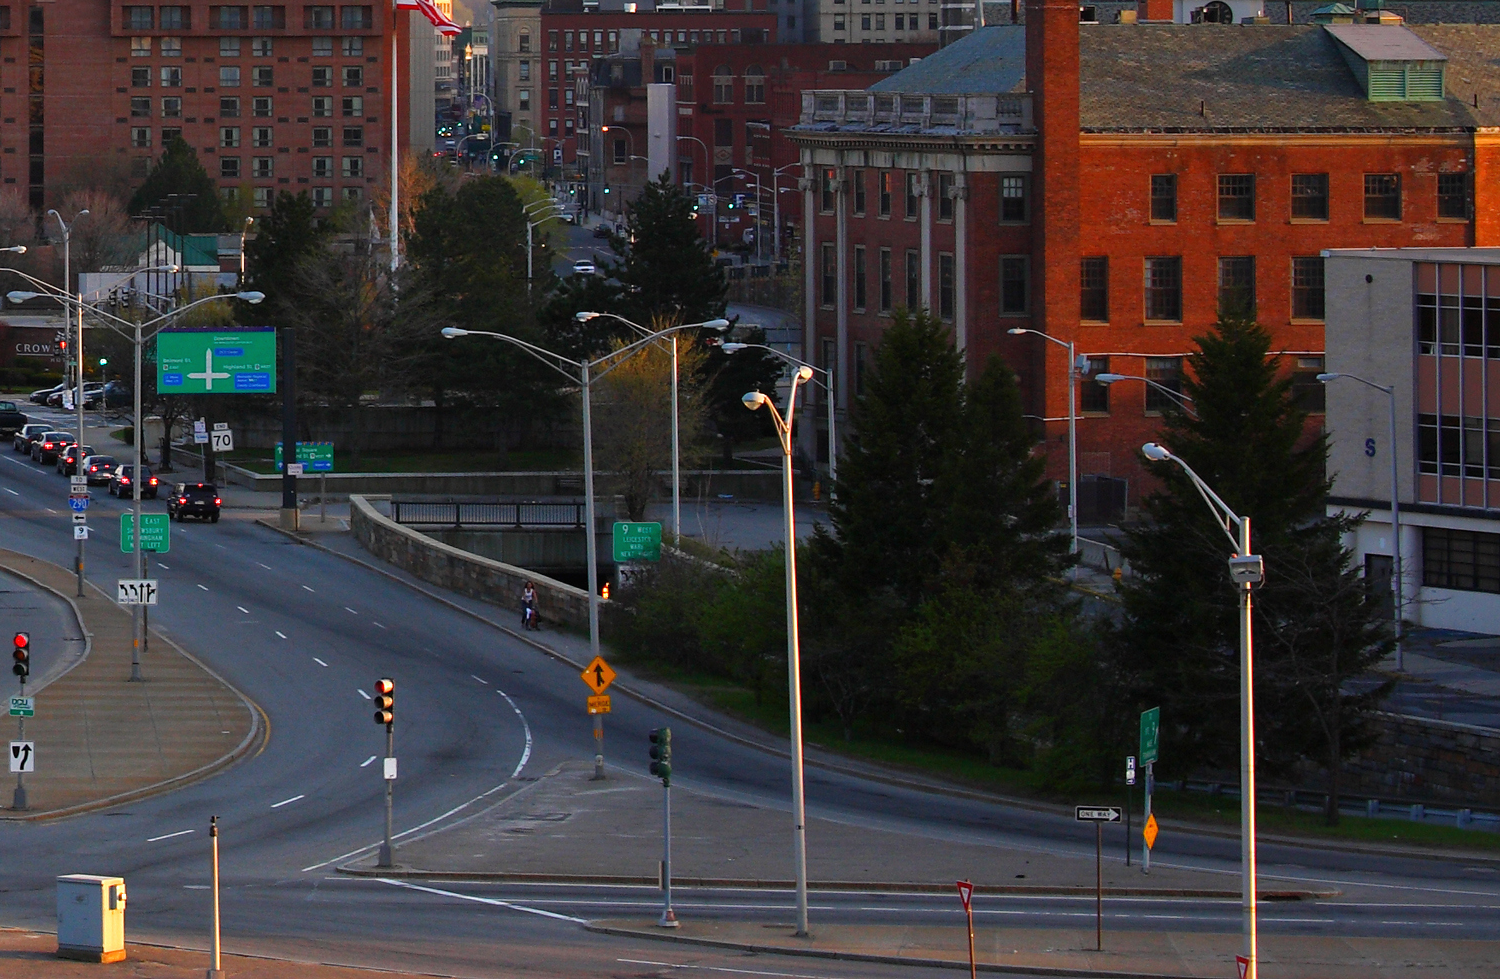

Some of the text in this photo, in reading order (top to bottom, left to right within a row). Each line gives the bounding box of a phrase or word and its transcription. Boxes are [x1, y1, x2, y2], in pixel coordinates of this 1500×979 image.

[16, 344, 50, 352] CROW
[213, 434, 230, 446] 70
[1365, 438, 1376, 457] S
[73, 499, 86, 508] 290
[622, 524, 628, 534] 9
[1128, 759, 1134, 768] H
